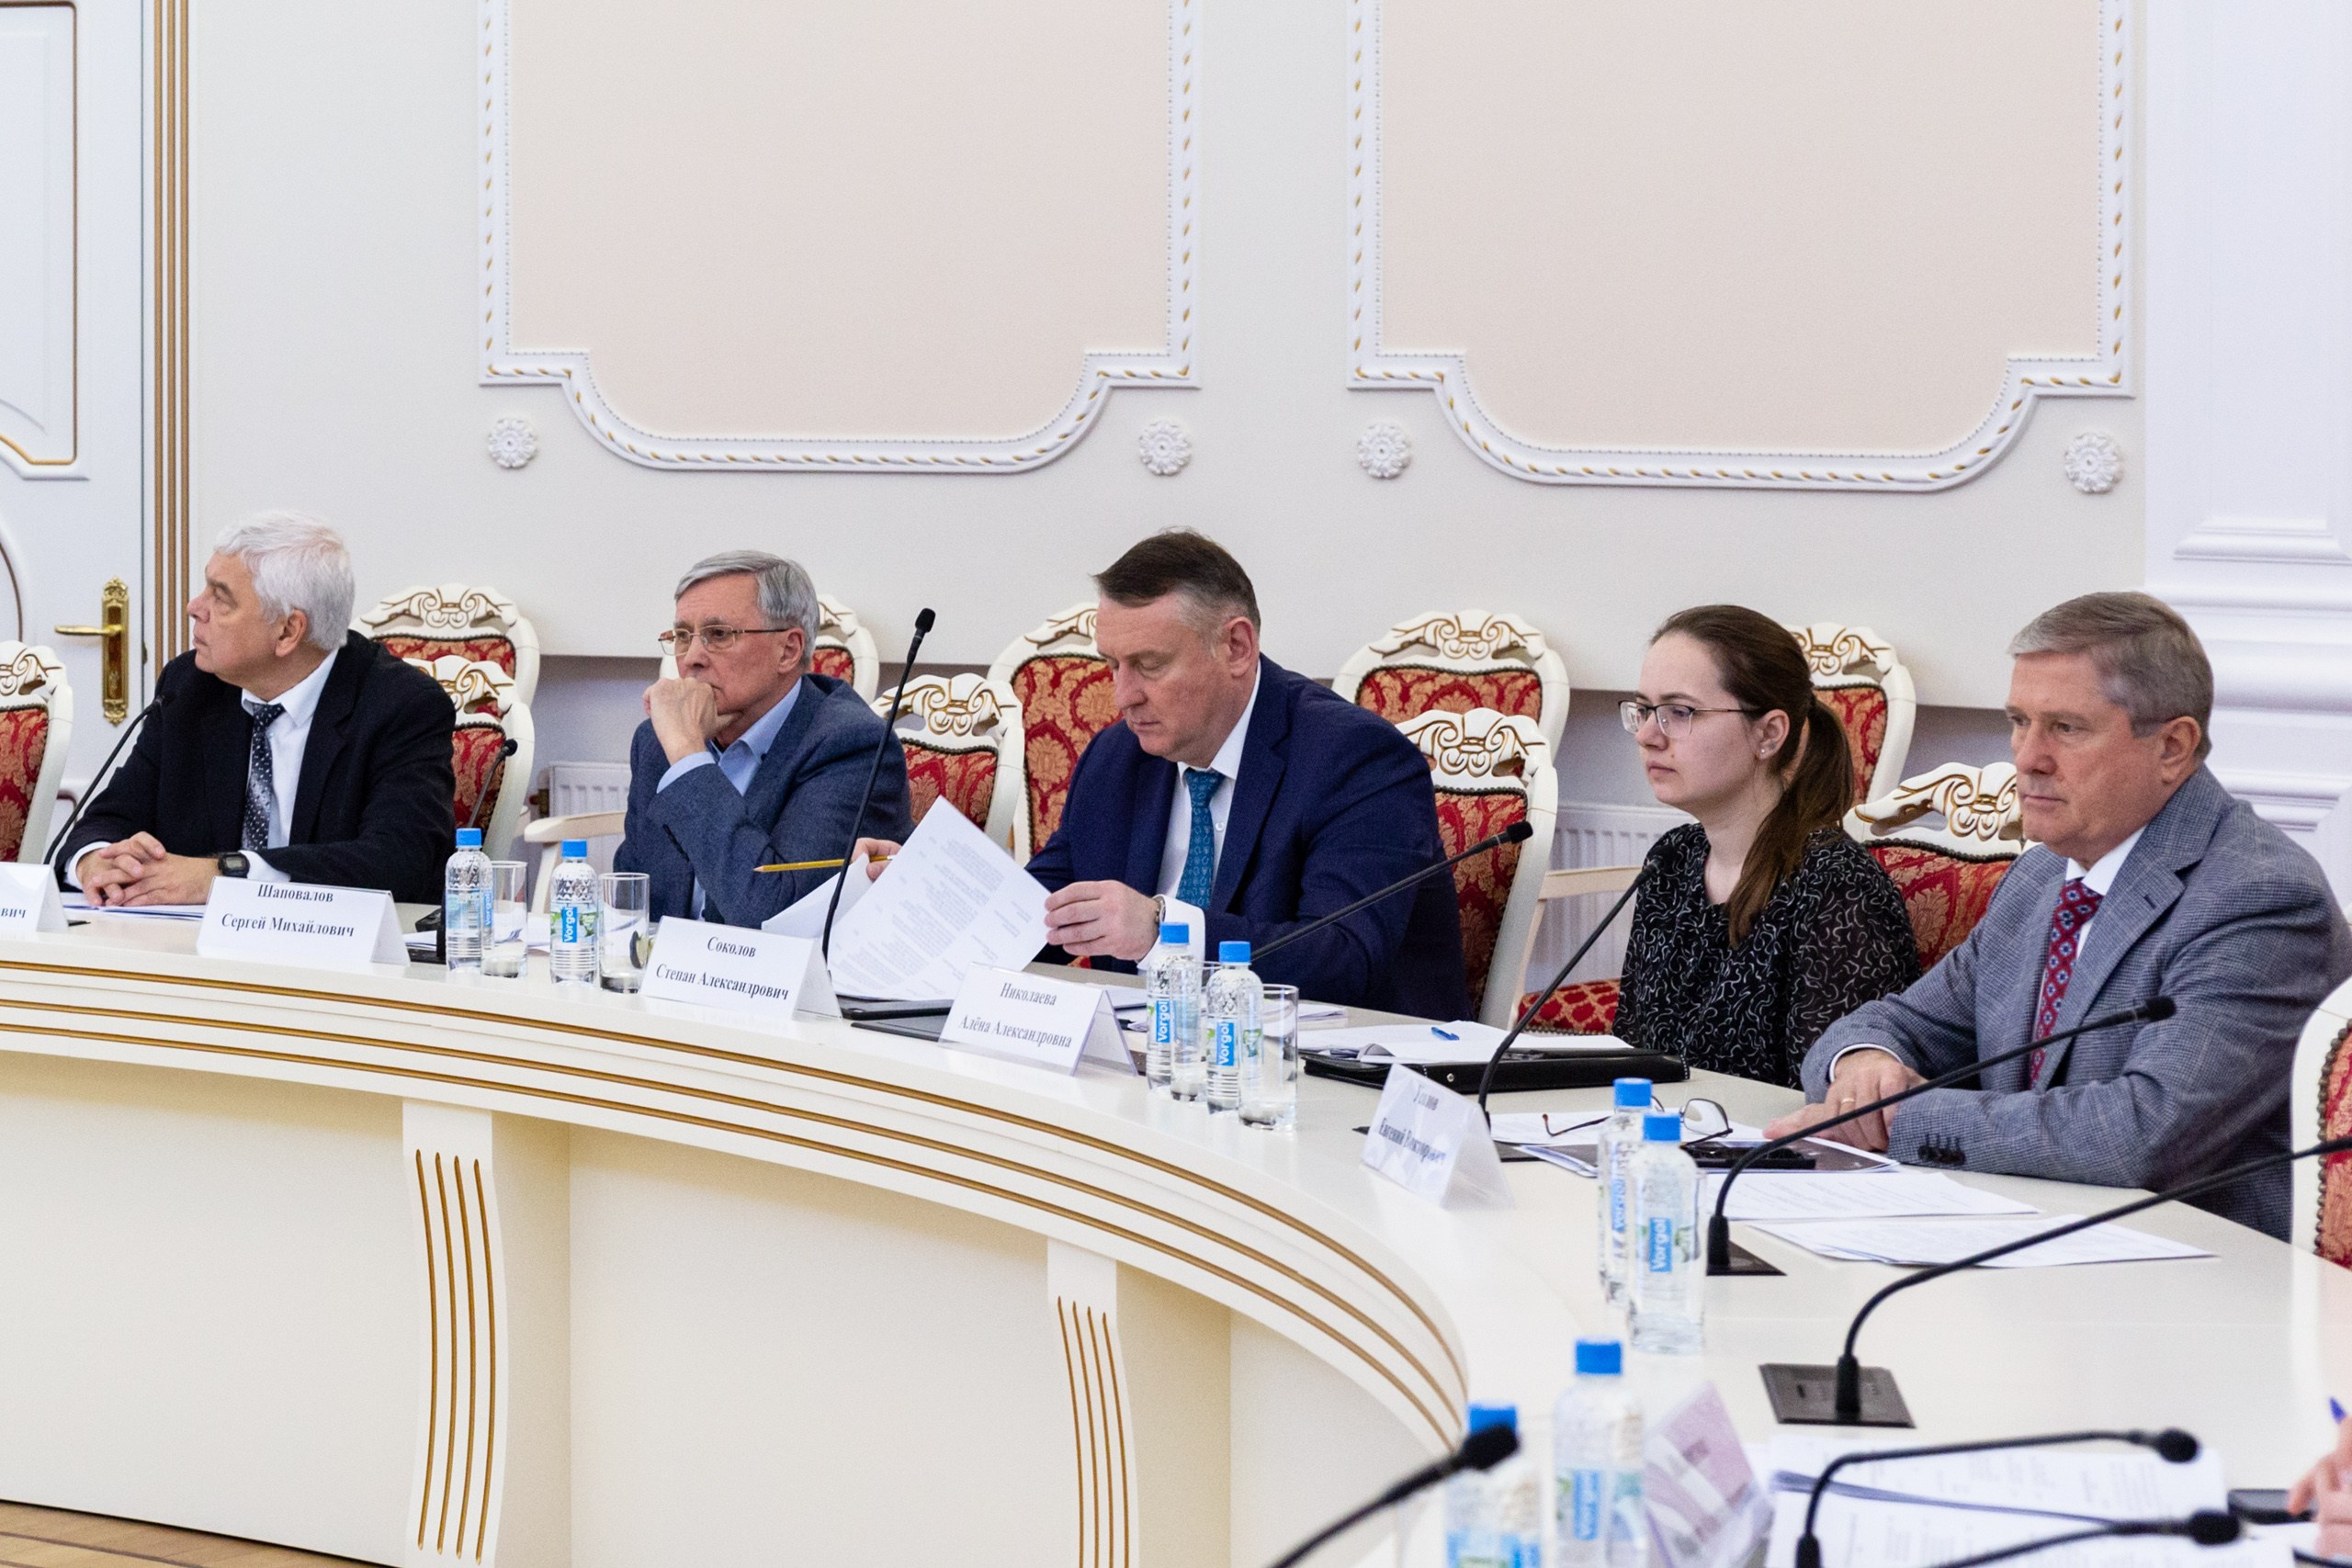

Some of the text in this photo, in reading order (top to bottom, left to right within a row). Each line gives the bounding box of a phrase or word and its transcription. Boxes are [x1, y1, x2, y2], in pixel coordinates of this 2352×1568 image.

[257, 884, 334, 903] Шаповалов
[221, 913, 355, 937] Сергей Михайлович
[563, 907, 574, 942] Vorgol
[707, 936, 757, 957] Соколов
[656, 964, 789, 1000] Степан Александрович
[1000, 982, 1057, 1006] Николаева
[958, 1014, 1072, 1048] Алёна Александровна
[1157, 1000, 1170, 1042] Vorgol
[1218, 1021, 1233, 1065] Vorgol
[1653, 1218, 1670, 1270] Vorgol
